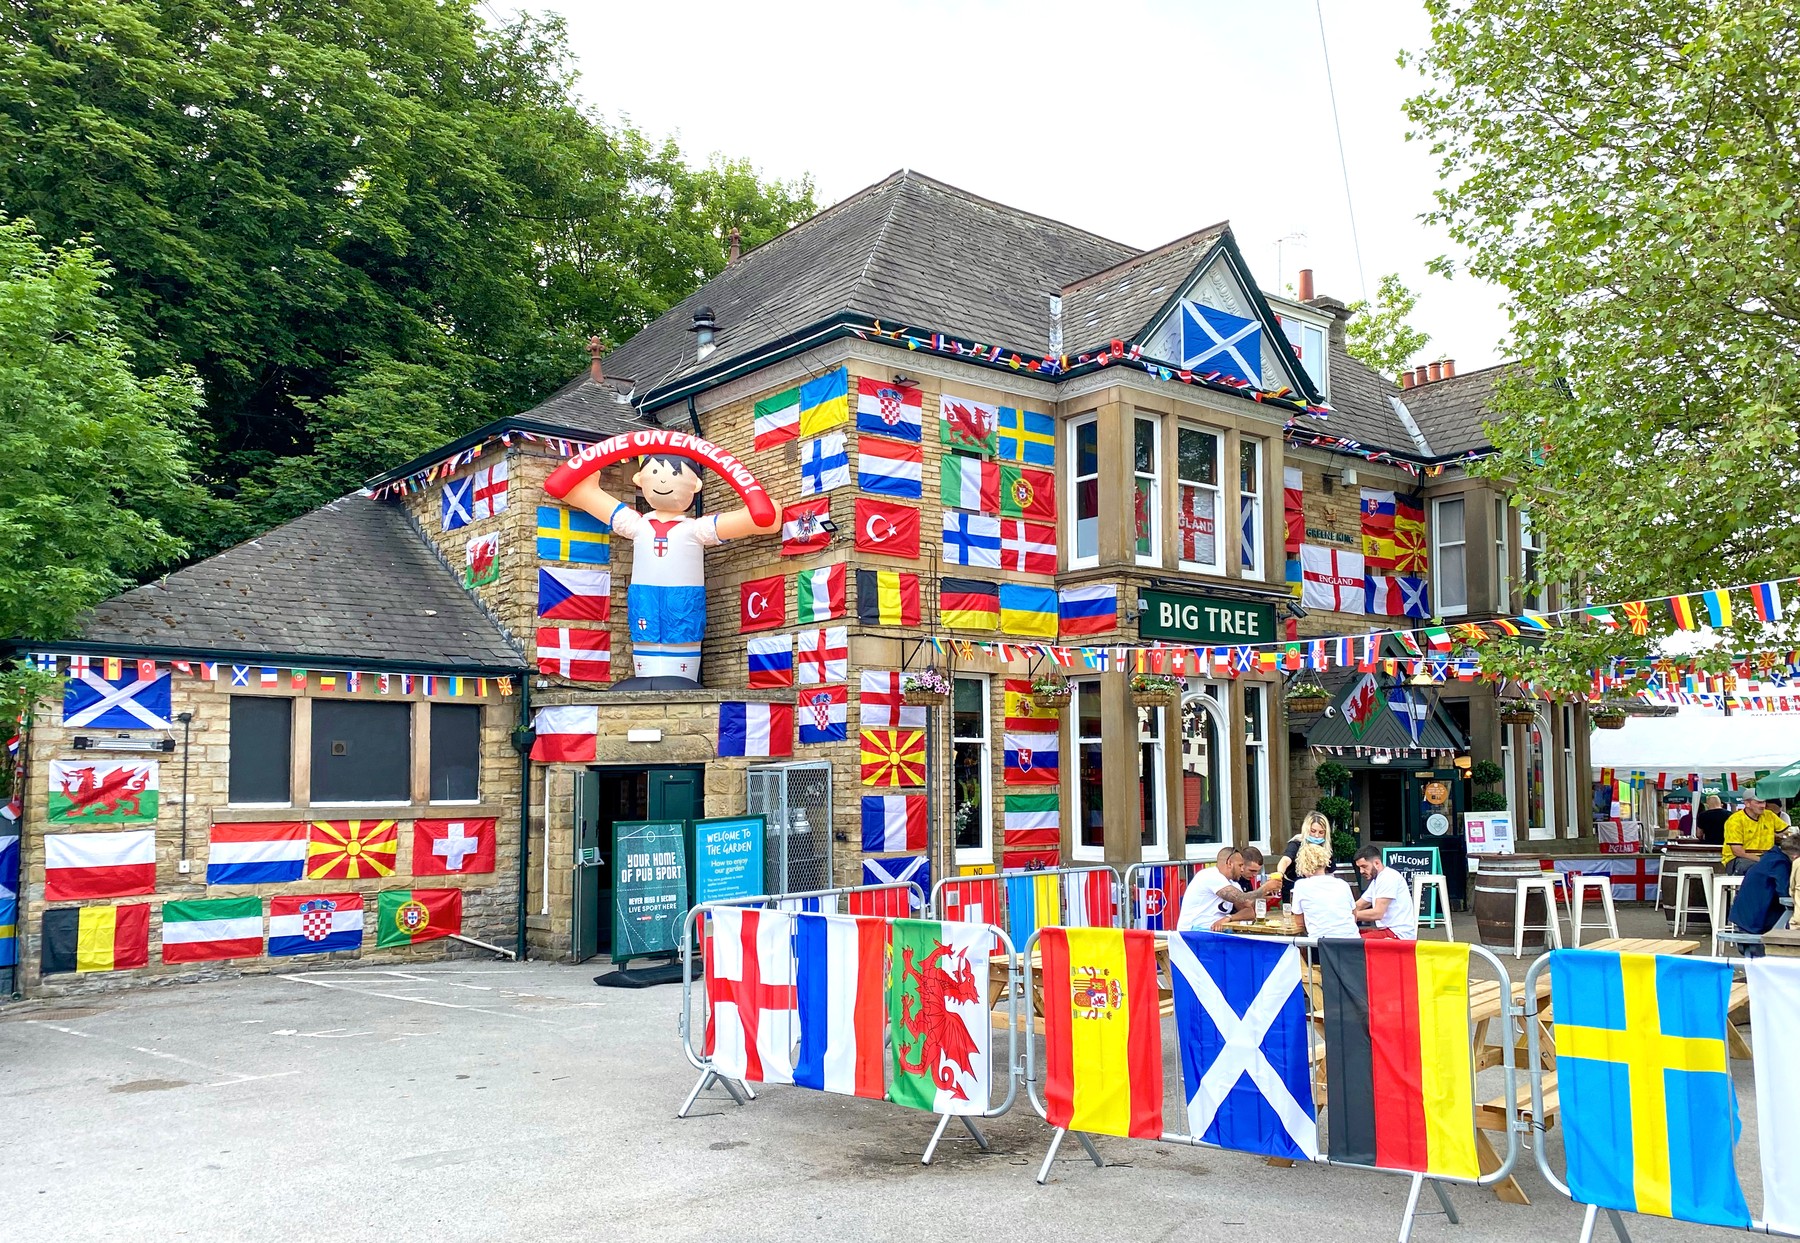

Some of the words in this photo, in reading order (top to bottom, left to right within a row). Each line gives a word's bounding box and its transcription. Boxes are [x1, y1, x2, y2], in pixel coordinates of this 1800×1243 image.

[567, 433, 629, 469] COME
[634, 431, 668, 446] ON
[669, 432, 762, 494] ENGLAND!
[1179, 516, 1213, 532] GLAND
[1306, 528, 1336, 541] GREENE
[1337, 532, 1354, 544] KING
[1318, 574, 1354, 586] ENGLAND
[1160, 602, 1199, 630] BIG
[1204, 607, 1259, 636] TREE
[706, 830, 740, 843] WELCOME
[705, 844, 721, 856] THE
[722, 841, 752, 855] GARDEN
[627, 853, 650, 868] YOUR
[652, 851, 677, 866] HOME
[621, 869, 633, 883] OF
[635, 867, 653, 882] PUB
[655, 866, 682, 880] SPORT
[973, 867, 983, 875] NO
[642, 904, 661, 912] SPORT
